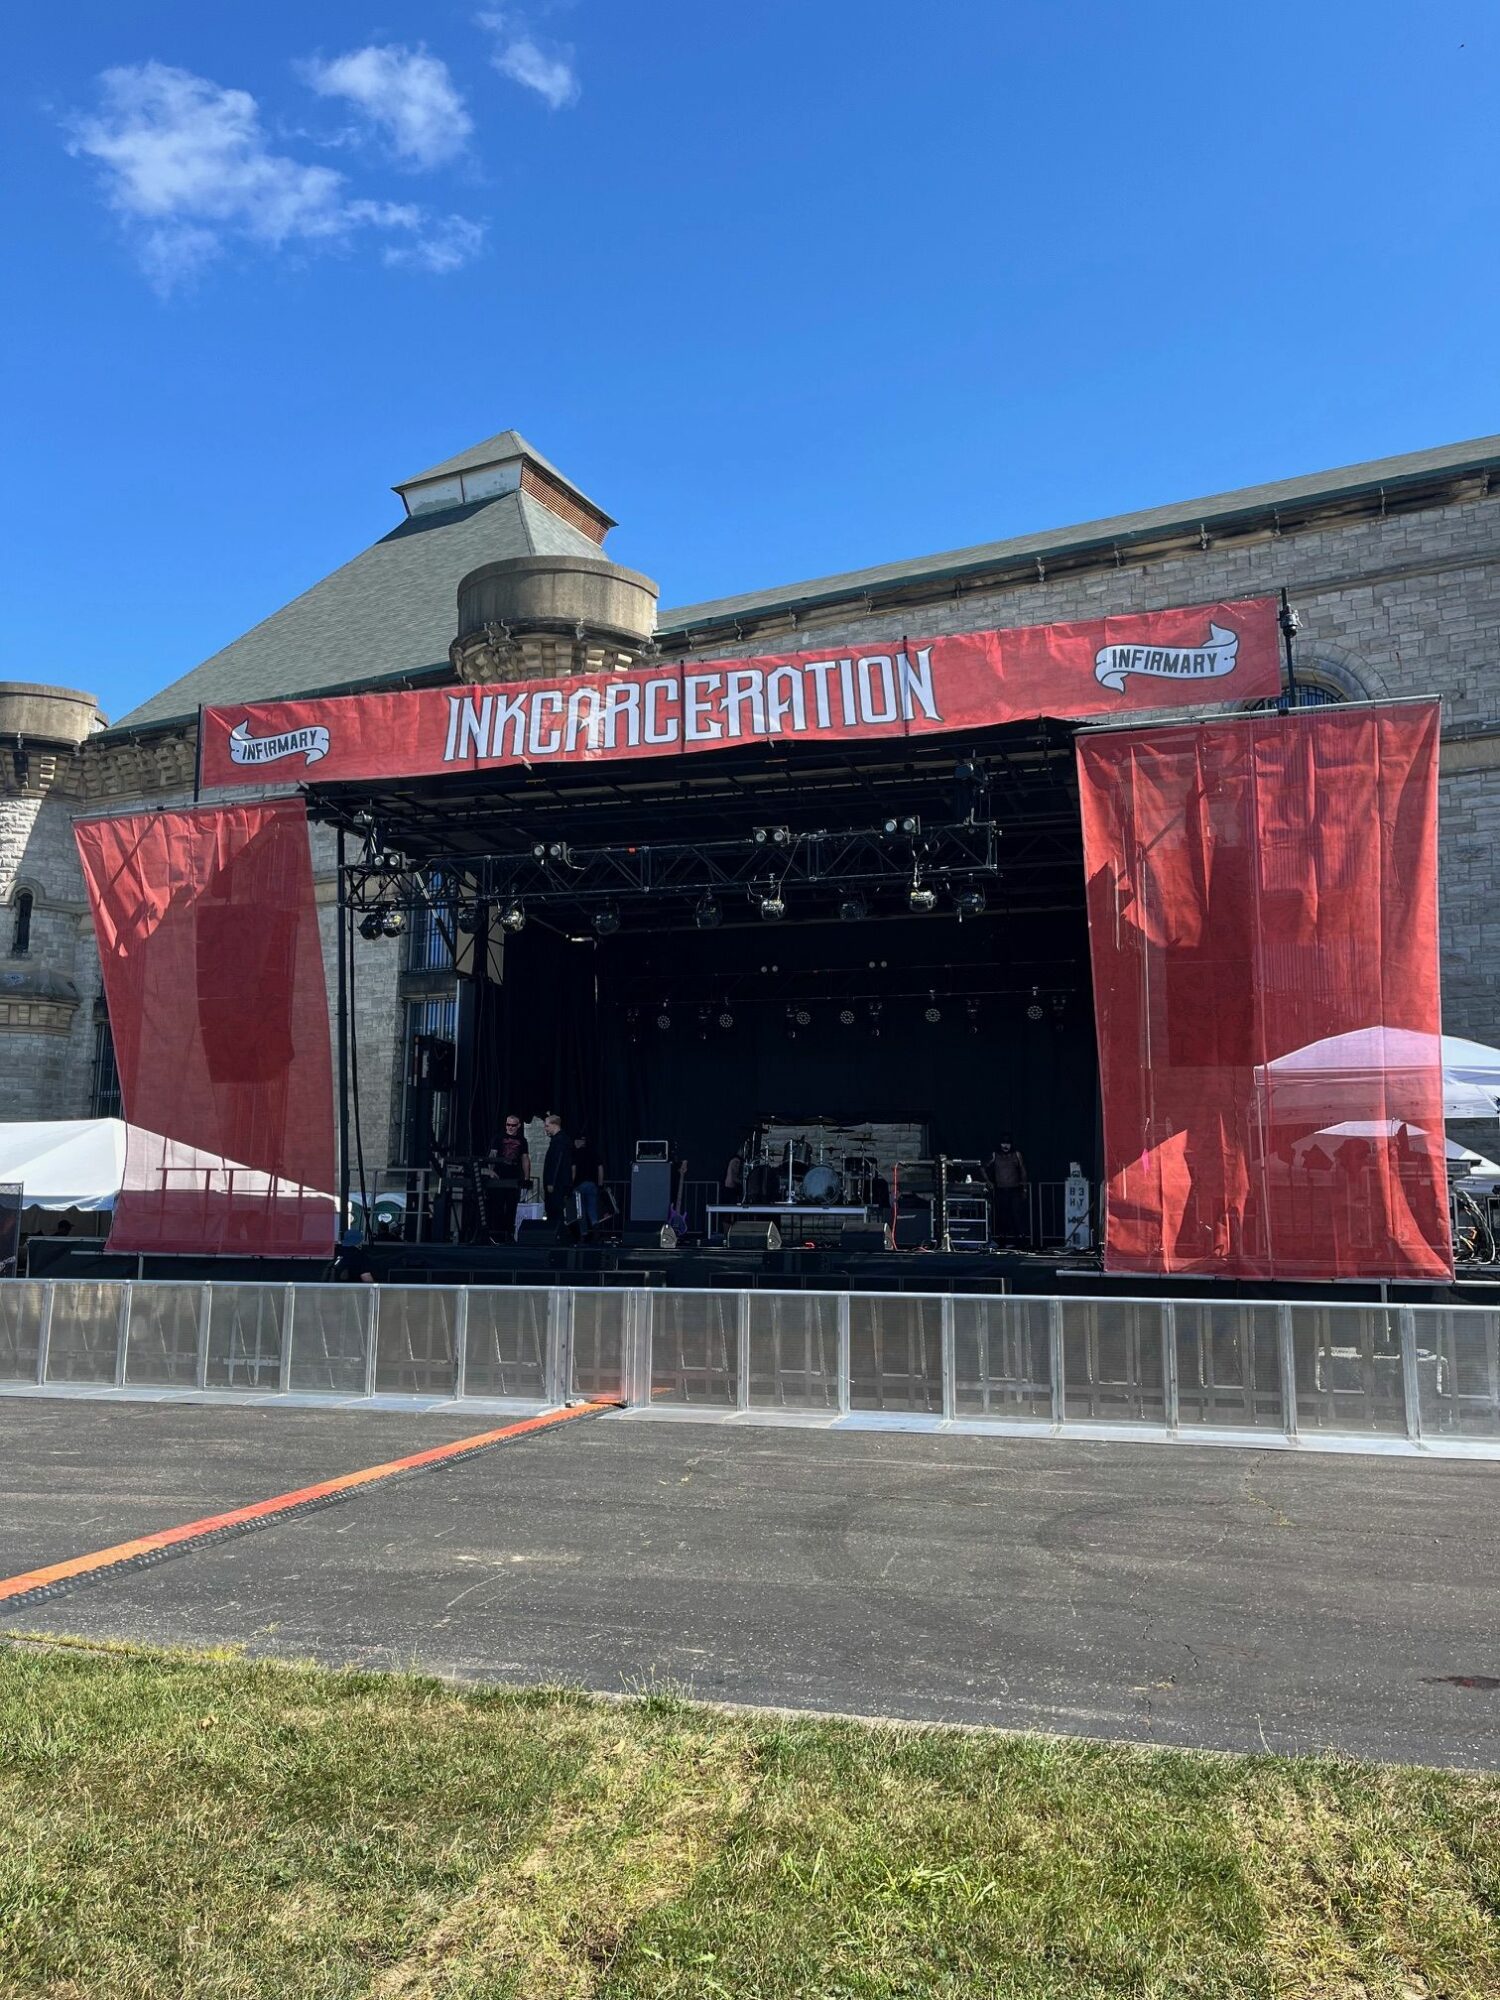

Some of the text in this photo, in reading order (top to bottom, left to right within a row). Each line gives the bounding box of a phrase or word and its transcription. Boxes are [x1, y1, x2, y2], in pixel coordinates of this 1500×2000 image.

[1112, 649, 1217, 674] INFIRMARY
[443, 645, 943, 761] INKCARCERATION
[242, 730, 317, 760] INFIRMARY
